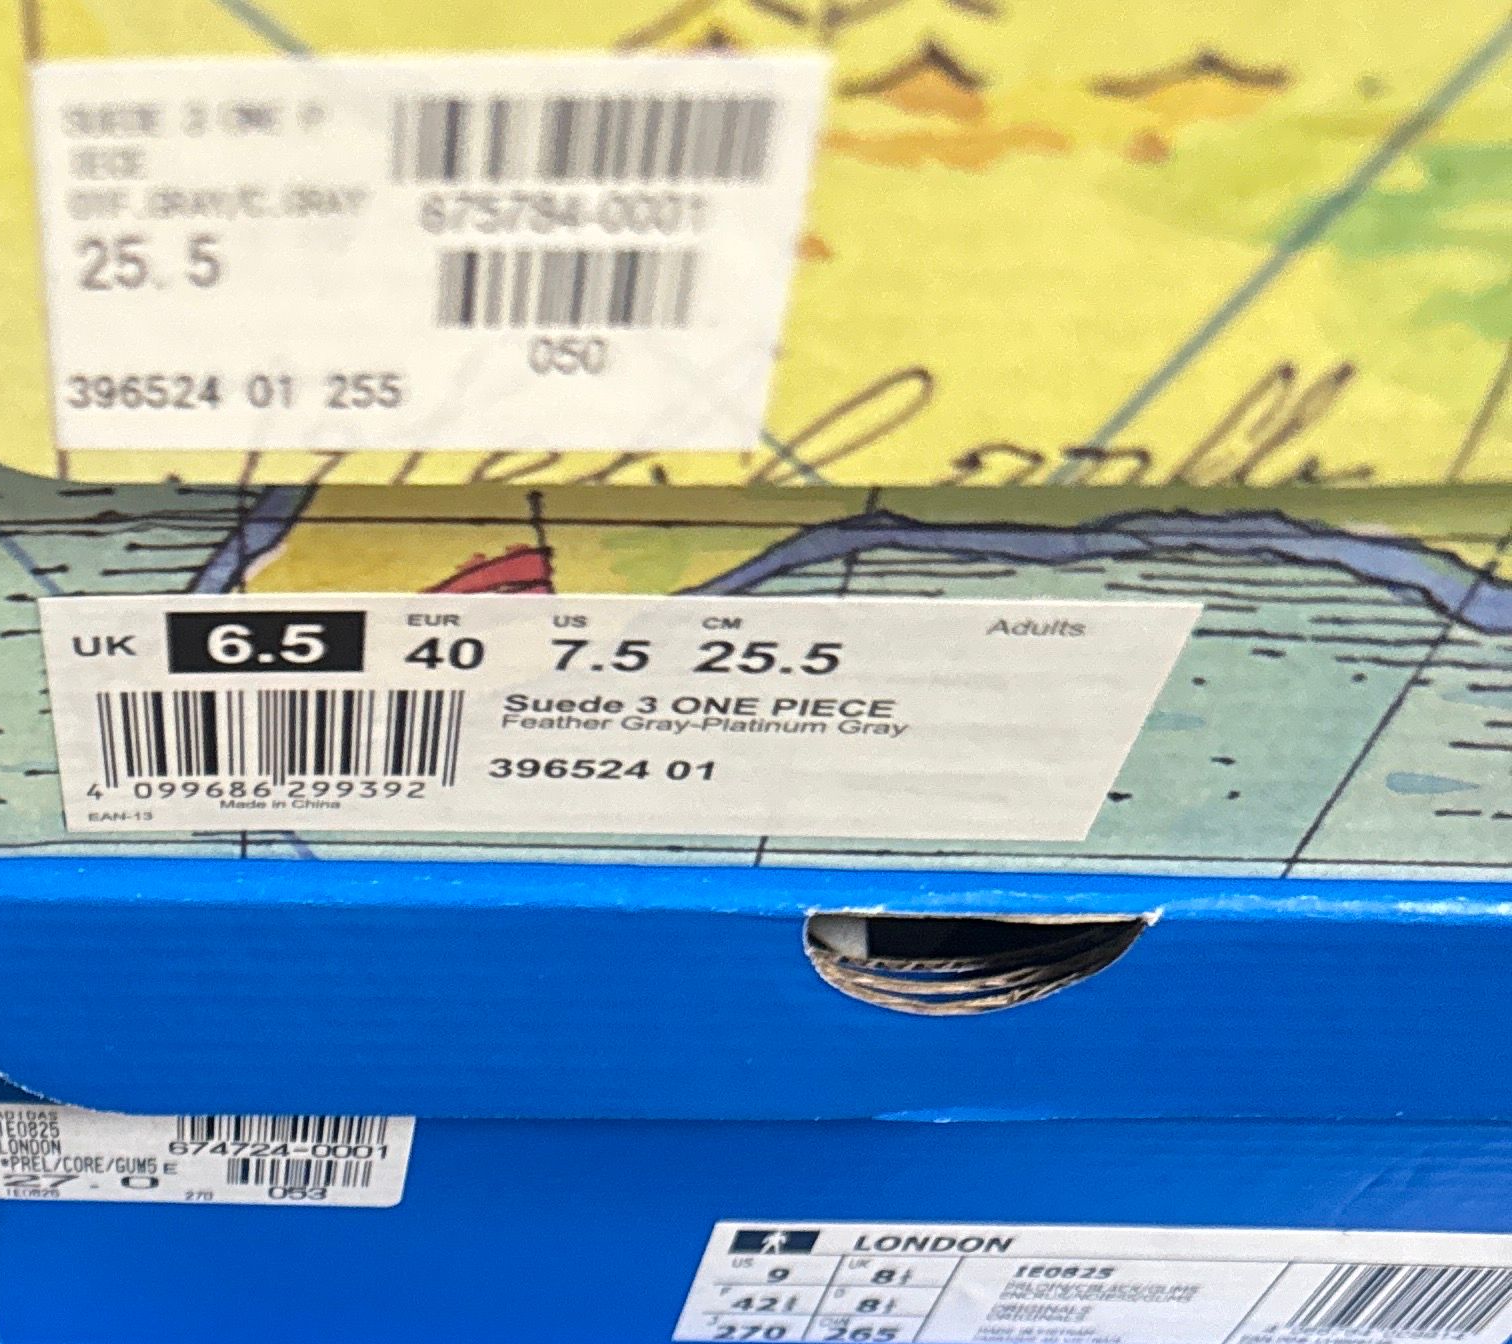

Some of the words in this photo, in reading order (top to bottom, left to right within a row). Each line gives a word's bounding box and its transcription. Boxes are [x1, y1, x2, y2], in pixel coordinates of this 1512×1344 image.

[68, 374, 221, 409] 396524
[246, 373, 296, 408] 01
[327, 372, 404, 409] 255
[406, 614, 461, 627] EUR
[553, 615, 587, 629] US
[702, 617, 743, 630] CM
[986, 618, 1086, 637] Adults
[73, 635, 137, 657] UK
[207, 624, 326, 664] 6.5
[405, 637, 484, 670] 40
[551, 639, 651, 673] 7.5
[693, 640, 843, 675] 25.5
[503, 694, 624, 715] Suede
[636, 696, 658, 715] 3
[672, 696, 758, 717] ONE
[771, 698, 897, 720] PIECE
[501, 714, 611, 732] Feather
[621, 715, 825, 736] Gray-Platinum
[837, 720, 909, 740] Gray
[488, 758, 649, 780] 396524
[666, 760, 716, 781] 01
[87, 783, 104, 801] 4
[134, 782, 272, 800] 099686
[288, 782, 426, 800] 299392
[220, 800, 267, 810] Made
[271, 799, 287, 810] in
[291, 799, 341, 811] China
[88, 812, 154, 822] EAN-13
[168, 1141, 388, 1159] 674724-0001
[268, 1186, 328, 1200] 053
[854, 1235, 1015, 1253] LONDON
[767, 1268, 790, 1283] 9
[1014, 1265, 1116, 1279] IE0825
[712, 1325, 788, 1340] 270
[823, 1328, 899, 1342] 265
